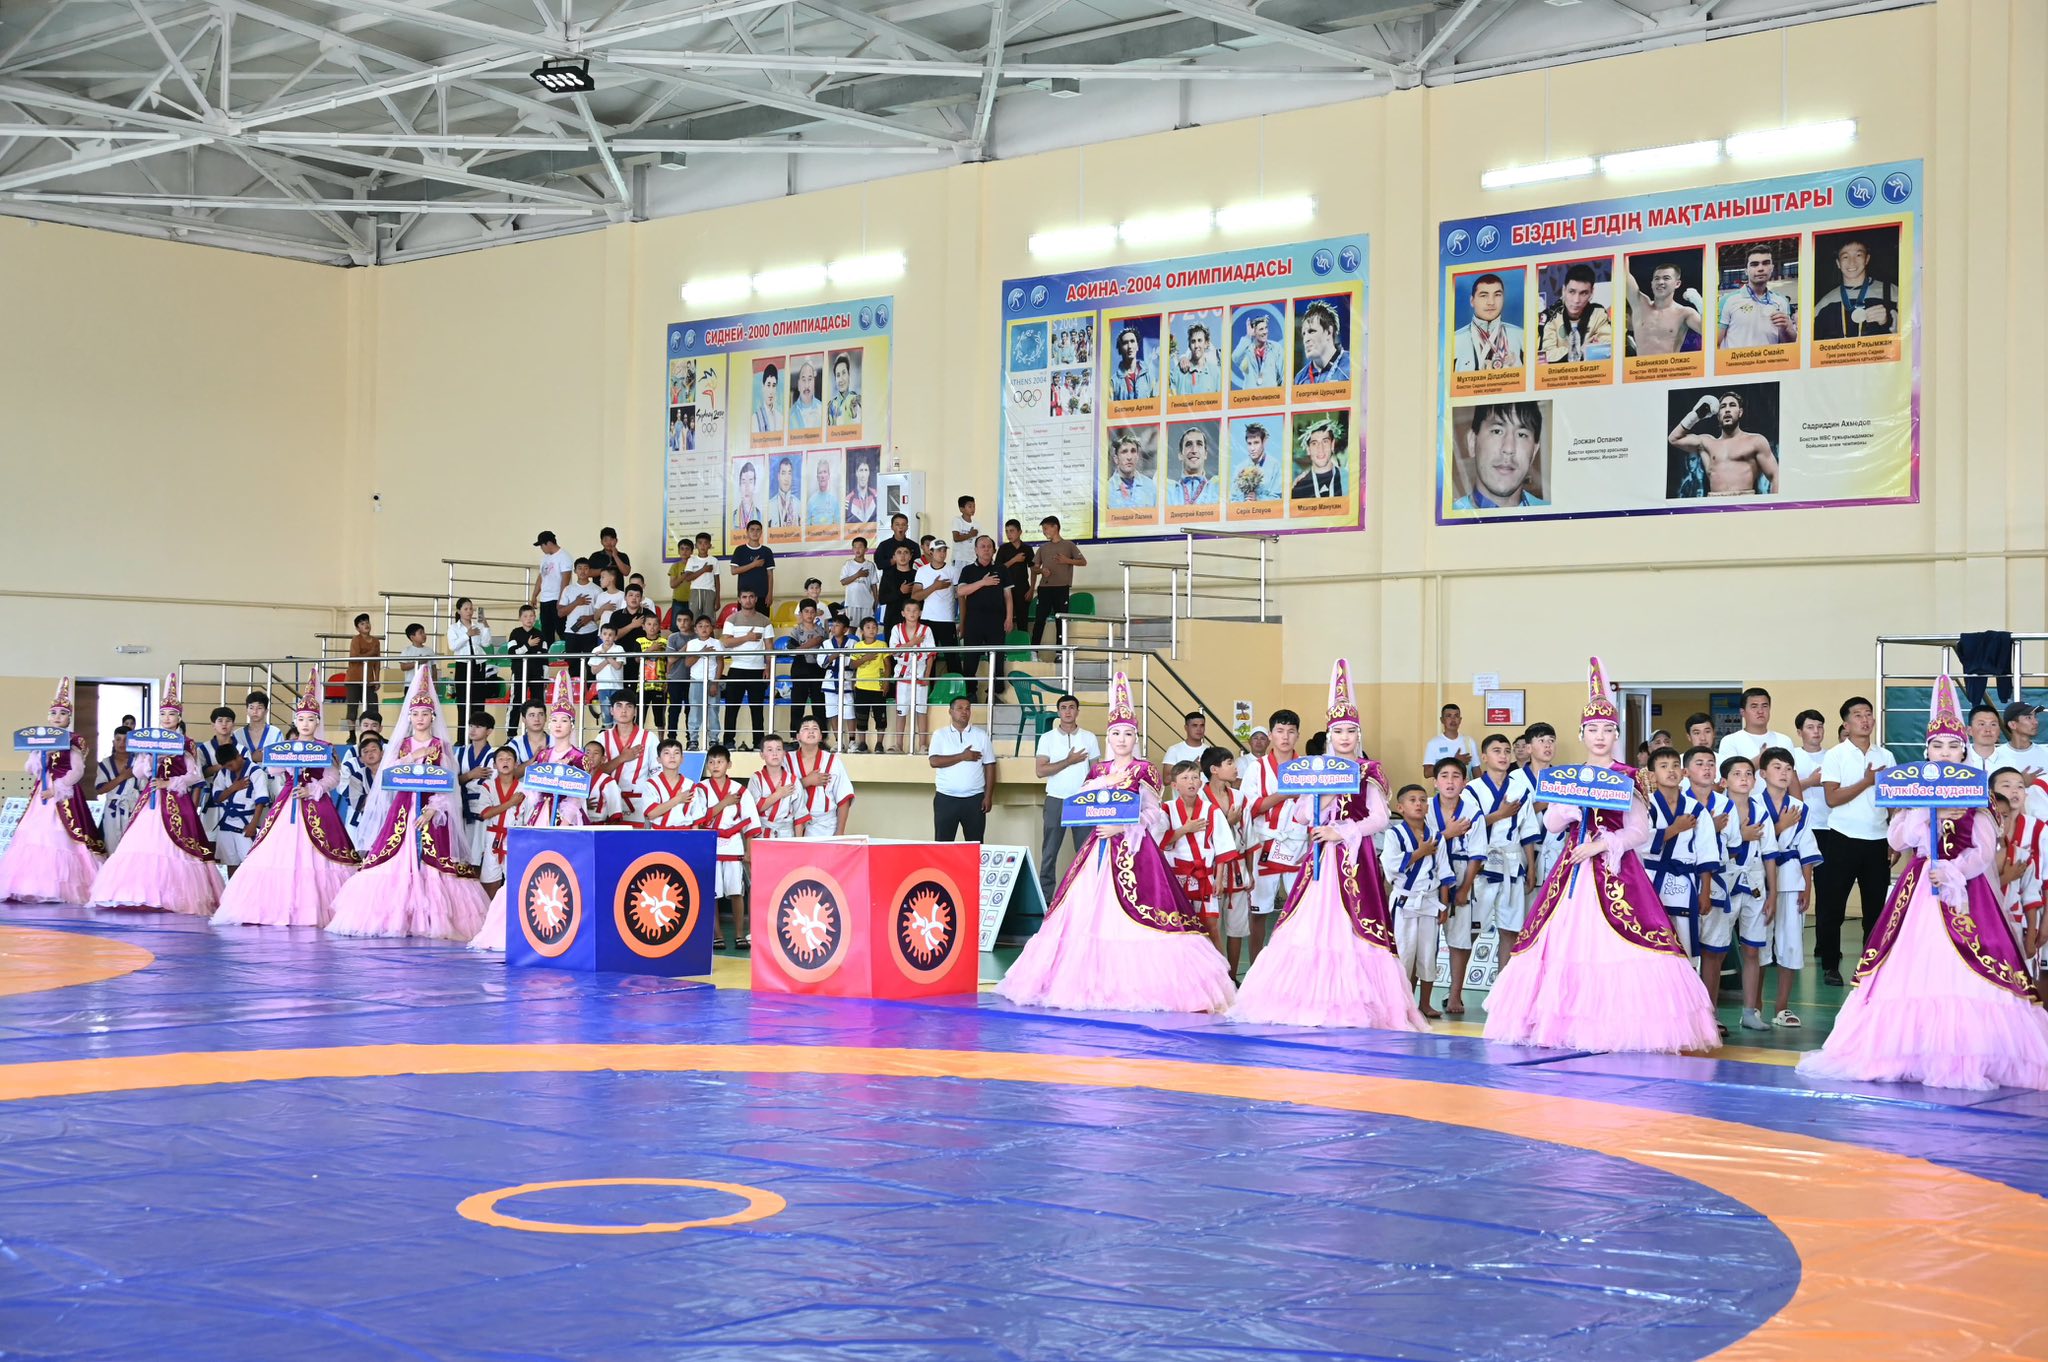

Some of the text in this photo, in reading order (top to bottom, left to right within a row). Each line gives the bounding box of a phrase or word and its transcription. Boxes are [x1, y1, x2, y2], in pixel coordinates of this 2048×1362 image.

[1512, 187, 1833, 245] БІЗДІҢ ЕЛДІҢ МАҚТАНЫШТАРЫ
[1165, 257, 1293, 289] ОЛИМПИАДАСЫ
[772, 313, 852, 337] ОЛИМПИАДАСЫ
[297, 754, 328, 764] ауданы
[1283, 773, 1354, 787] Отырар ауданы
[1540, 780, 1631, 801] Байдібек ауданы
[1880, 782, 1985, 799] Түлкібас ауданы
[1085, 806, 1117, 818] Келес
